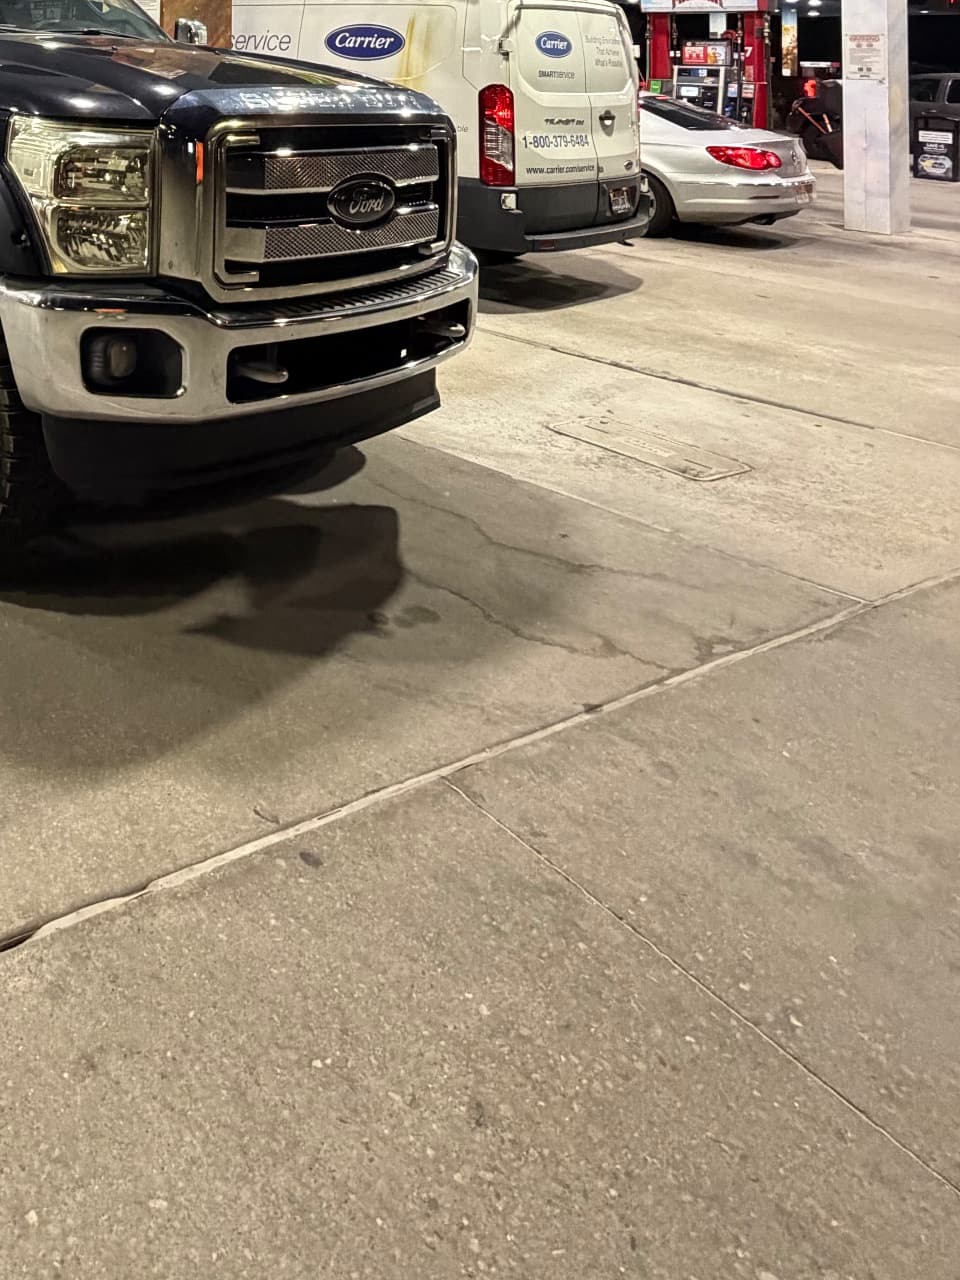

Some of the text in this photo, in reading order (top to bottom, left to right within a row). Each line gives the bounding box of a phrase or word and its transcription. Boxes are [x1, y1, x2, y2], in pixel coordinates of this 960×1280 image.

[335, 32, 394, 49] Carrier
[540, 37, 568, 50] Carrier
[744, 46, 753, 58] 7
[522, 134, 589, 149] 1-800-379-6484
[349, 191, 385, 214] Ford
